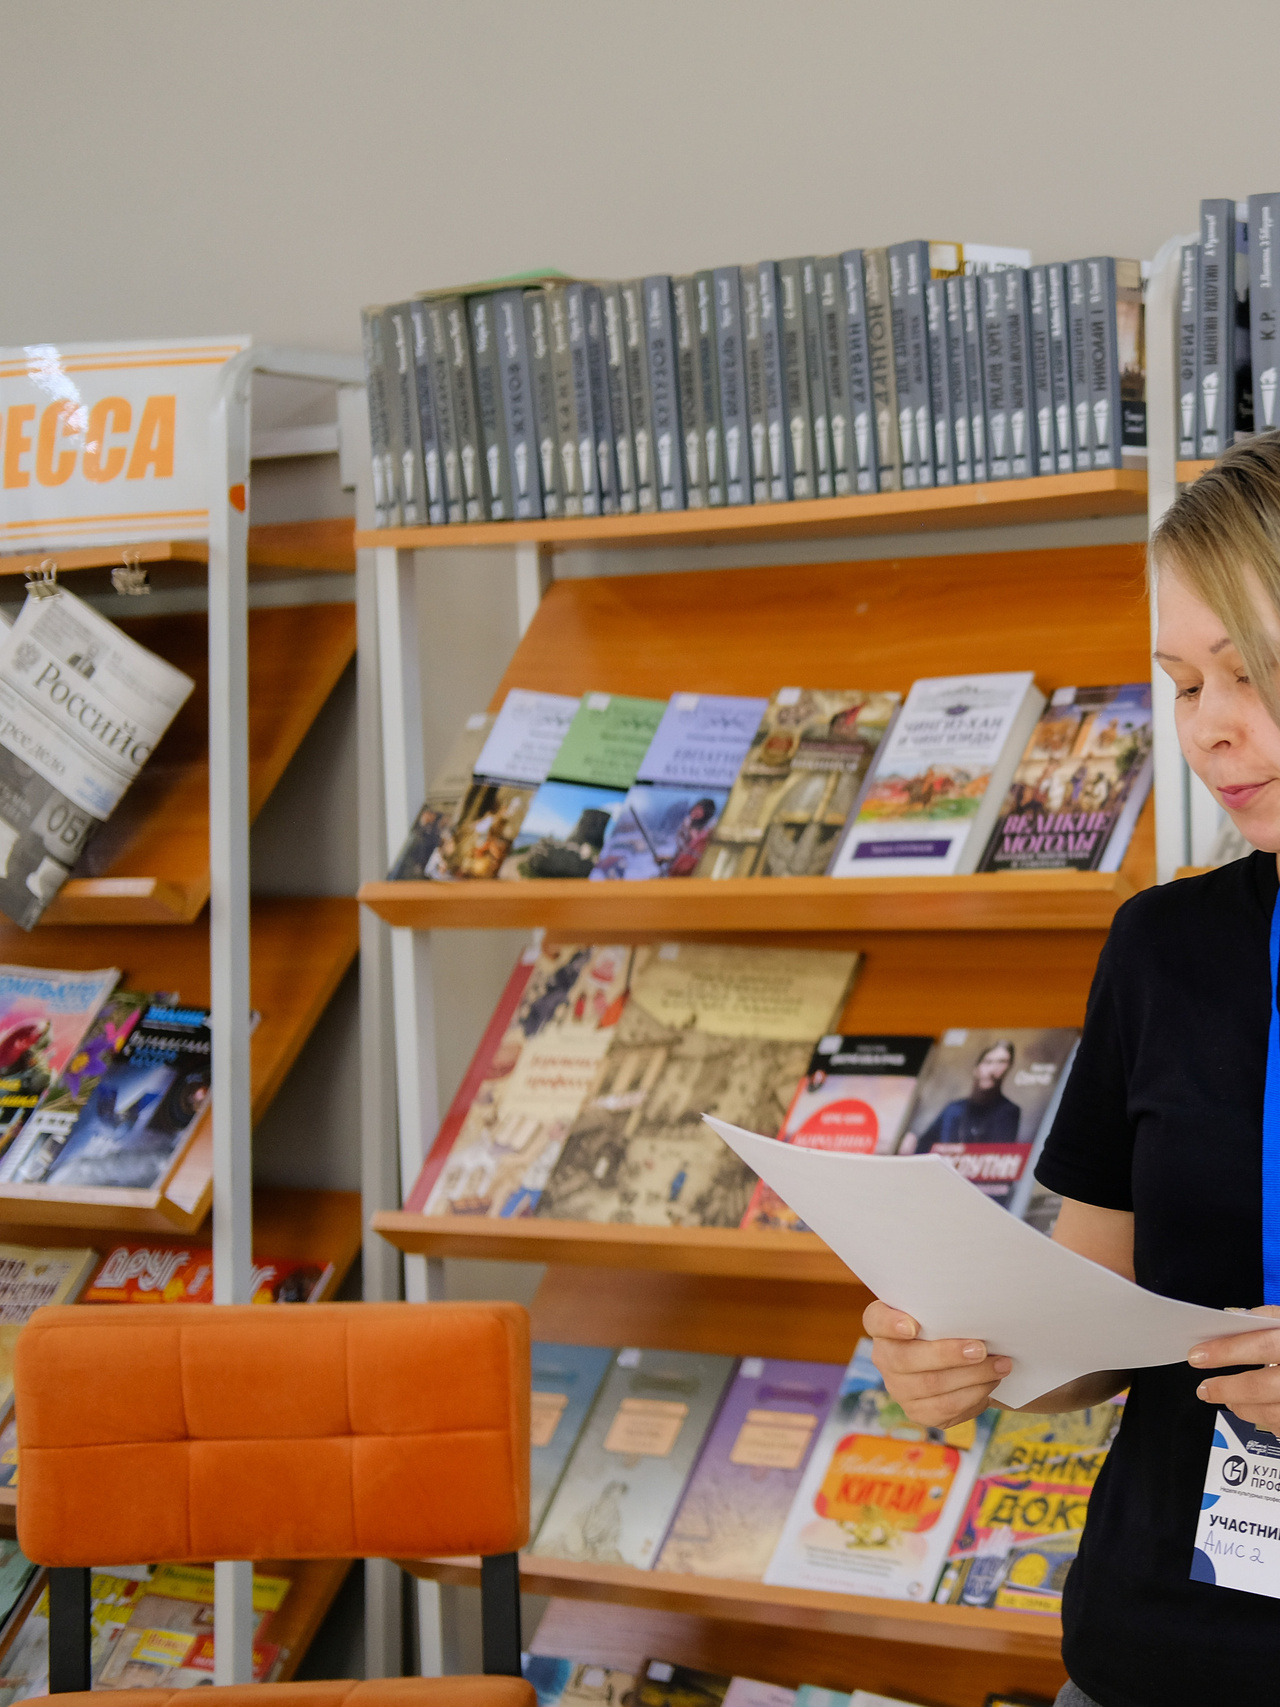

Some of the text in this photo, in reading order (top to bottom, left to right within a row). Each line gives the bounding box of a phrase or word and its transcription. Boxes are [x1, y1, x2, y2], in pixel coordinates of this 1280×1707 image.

[849, 322, 865, 403] ДАРВИН
[868, 303, 888, 406] ДАНТОН
[1181, 323, 1194, 380] ФРЕЙД
[507, 362, 525, 435] ЖУКОВ
[0, 395, 176, 489] ЕССА
[998, 833, 1097, 854] МОГОЛЫ
[1003, 812, 1111, 834] ВЕЛИКИЕ
